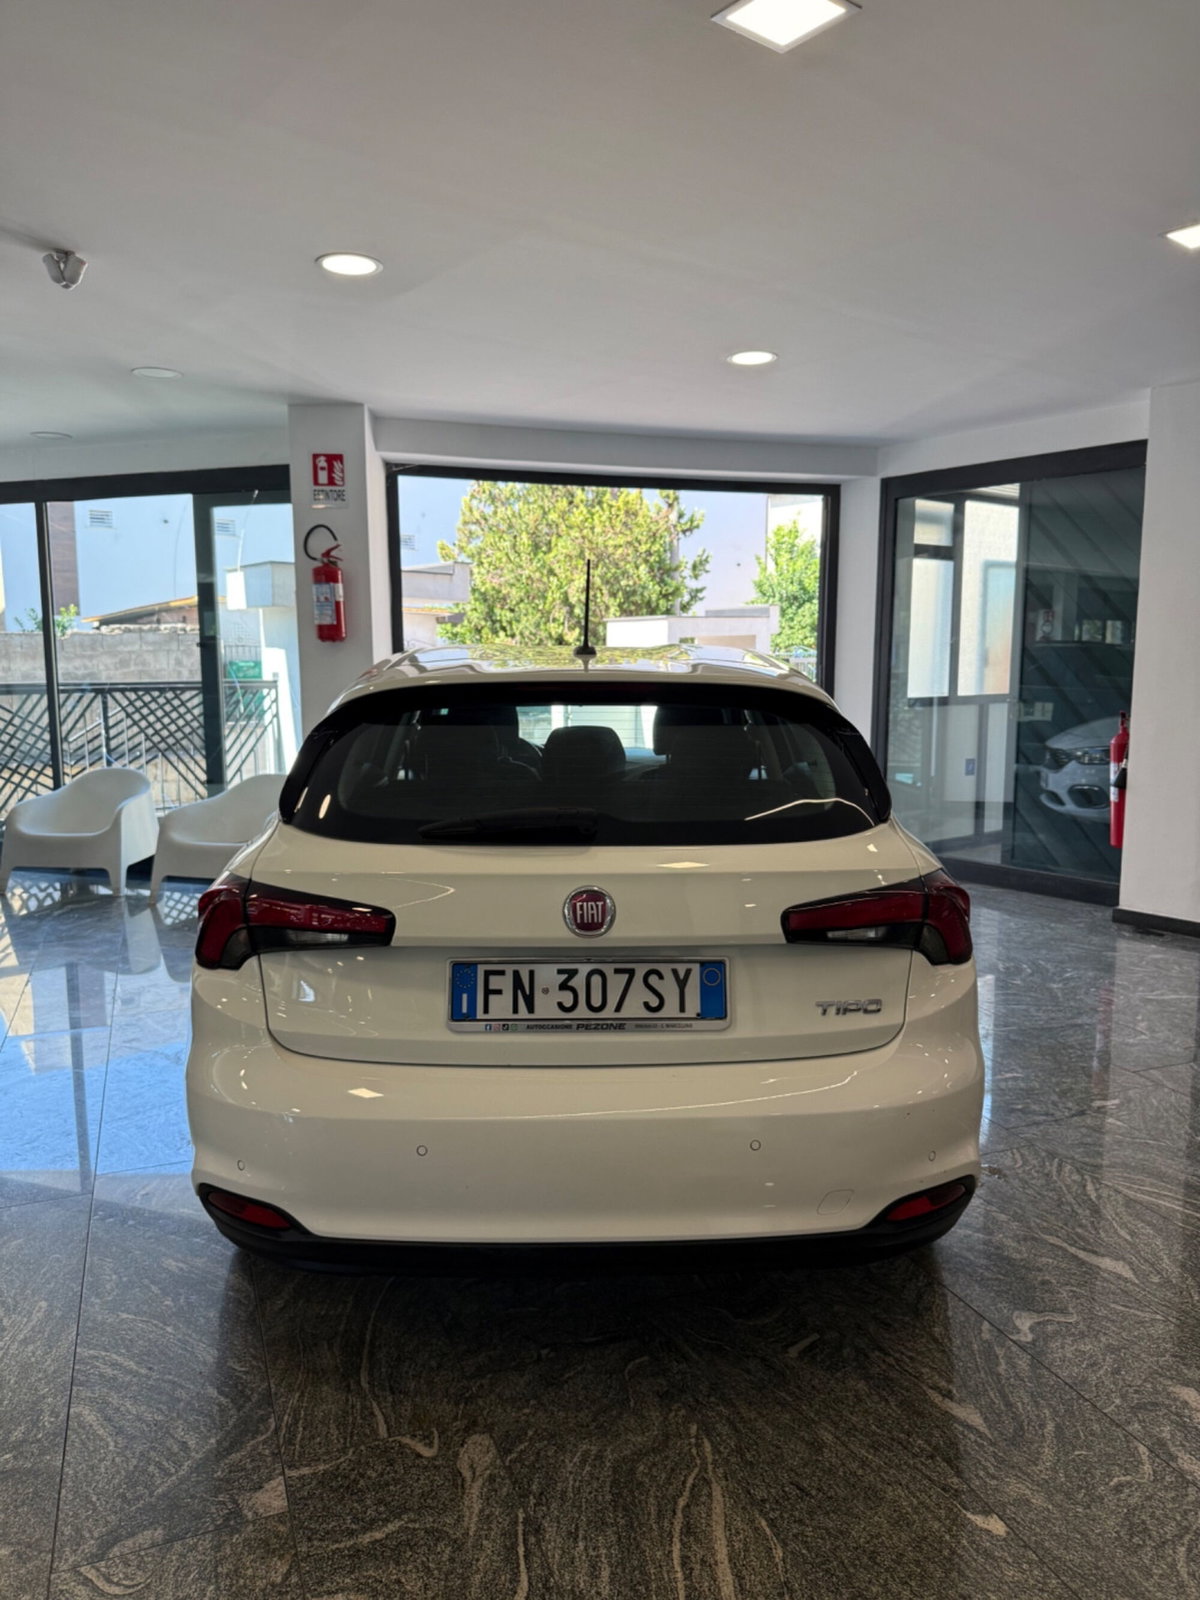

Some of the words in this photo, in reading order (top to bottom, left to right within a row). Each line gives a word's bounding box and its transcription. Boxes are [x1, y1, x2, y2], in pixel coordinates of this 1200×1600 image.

[576, 901, 604, 923] FIAT
[815, 998, 883, 1016] TIPO
[575, 1022, 627, 1031] PEZONE
